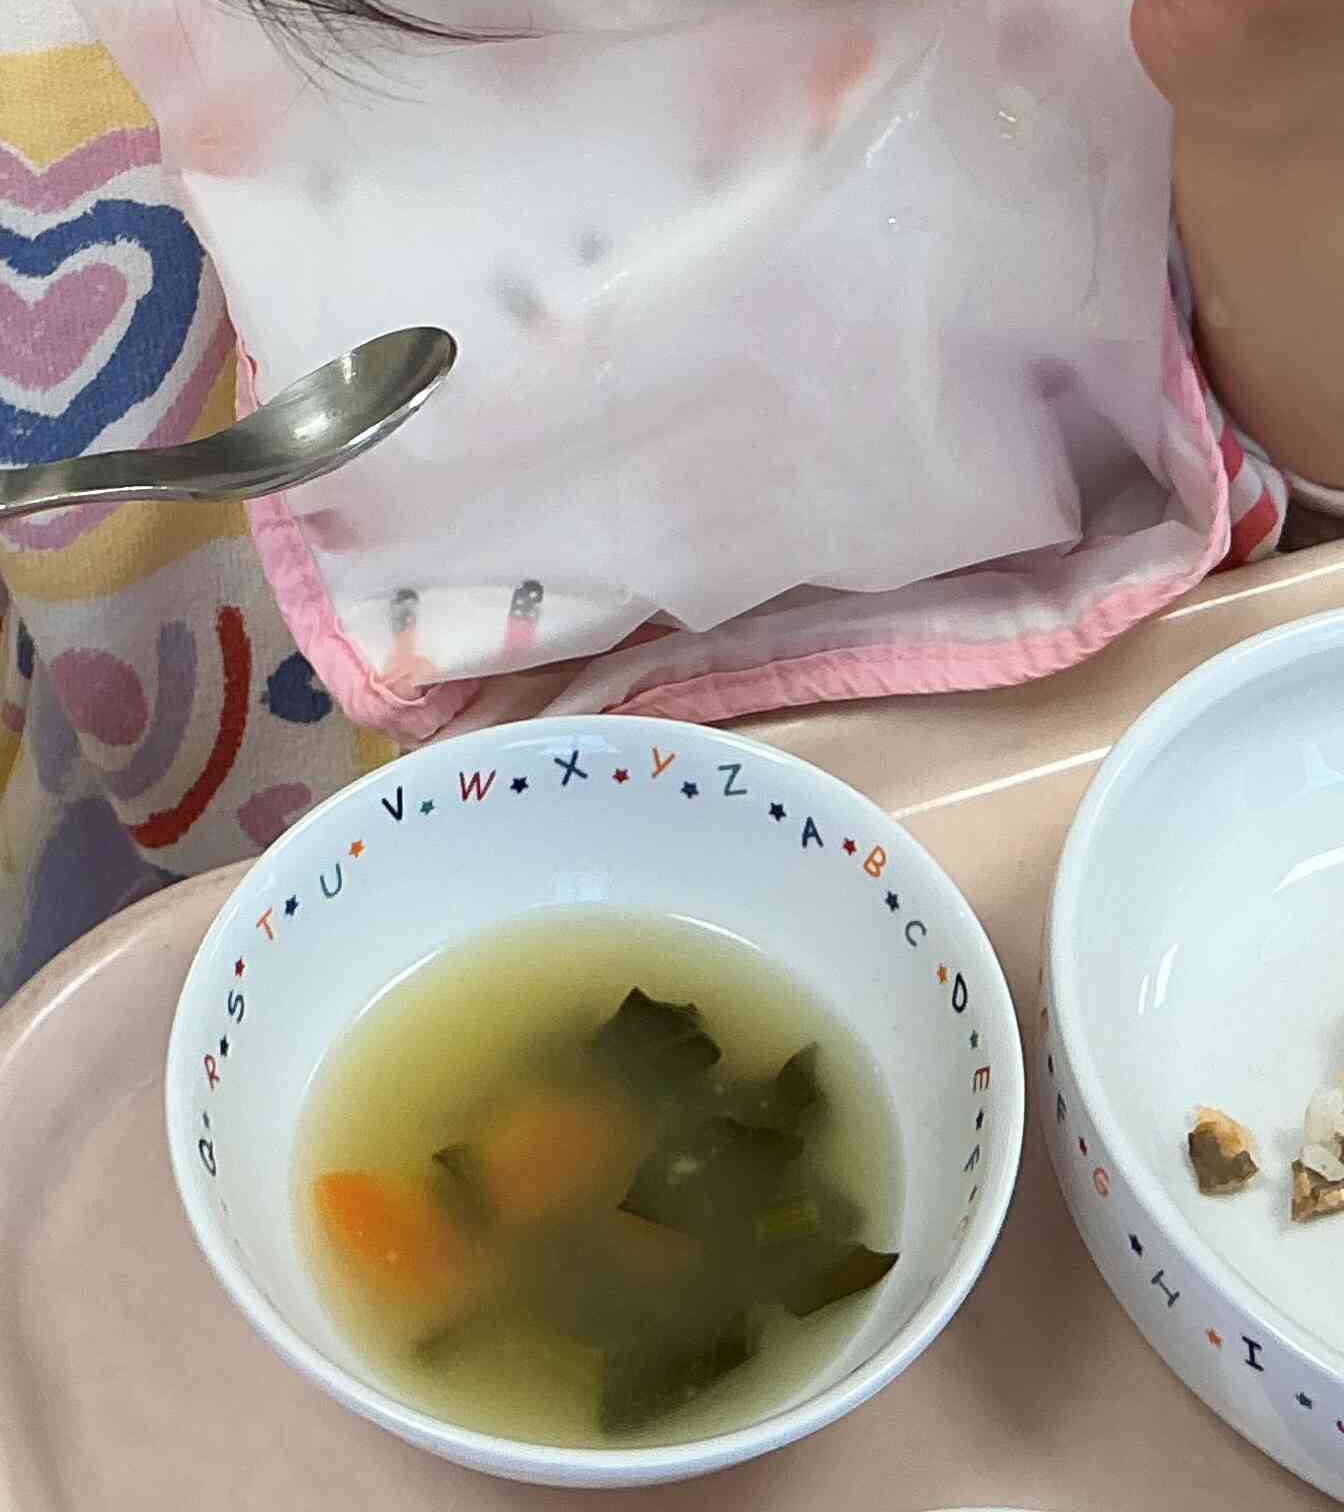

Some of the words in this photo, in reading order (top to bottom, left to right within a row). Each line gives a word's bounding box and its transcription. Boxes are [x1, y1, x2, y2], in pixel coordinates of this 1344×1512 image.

[204, 1054, 220, 1091] R
[228, 989, 245, 1024] S
[256, 907, 274, 940] T
[320, 863, 343, 899] U
[381, 786, 403, 821] V
[459, 769, 496, 801] W
[554, 749, 588, 786] X
[652, 746, 676, 779] Y
[717, 763, 748, 796] Z
[801, 816, 824, 849] A
[863, 845, 887, 878] B
[905, 920, 927, 948] C
[952, 972, 968, 1013] D
[973, 1065, 991, 1093] E
[1092, 1167, 1109, 1198] G
[1151, 1270, 1180, 1307] H
[1242, 1335, 1264, 1372] I
